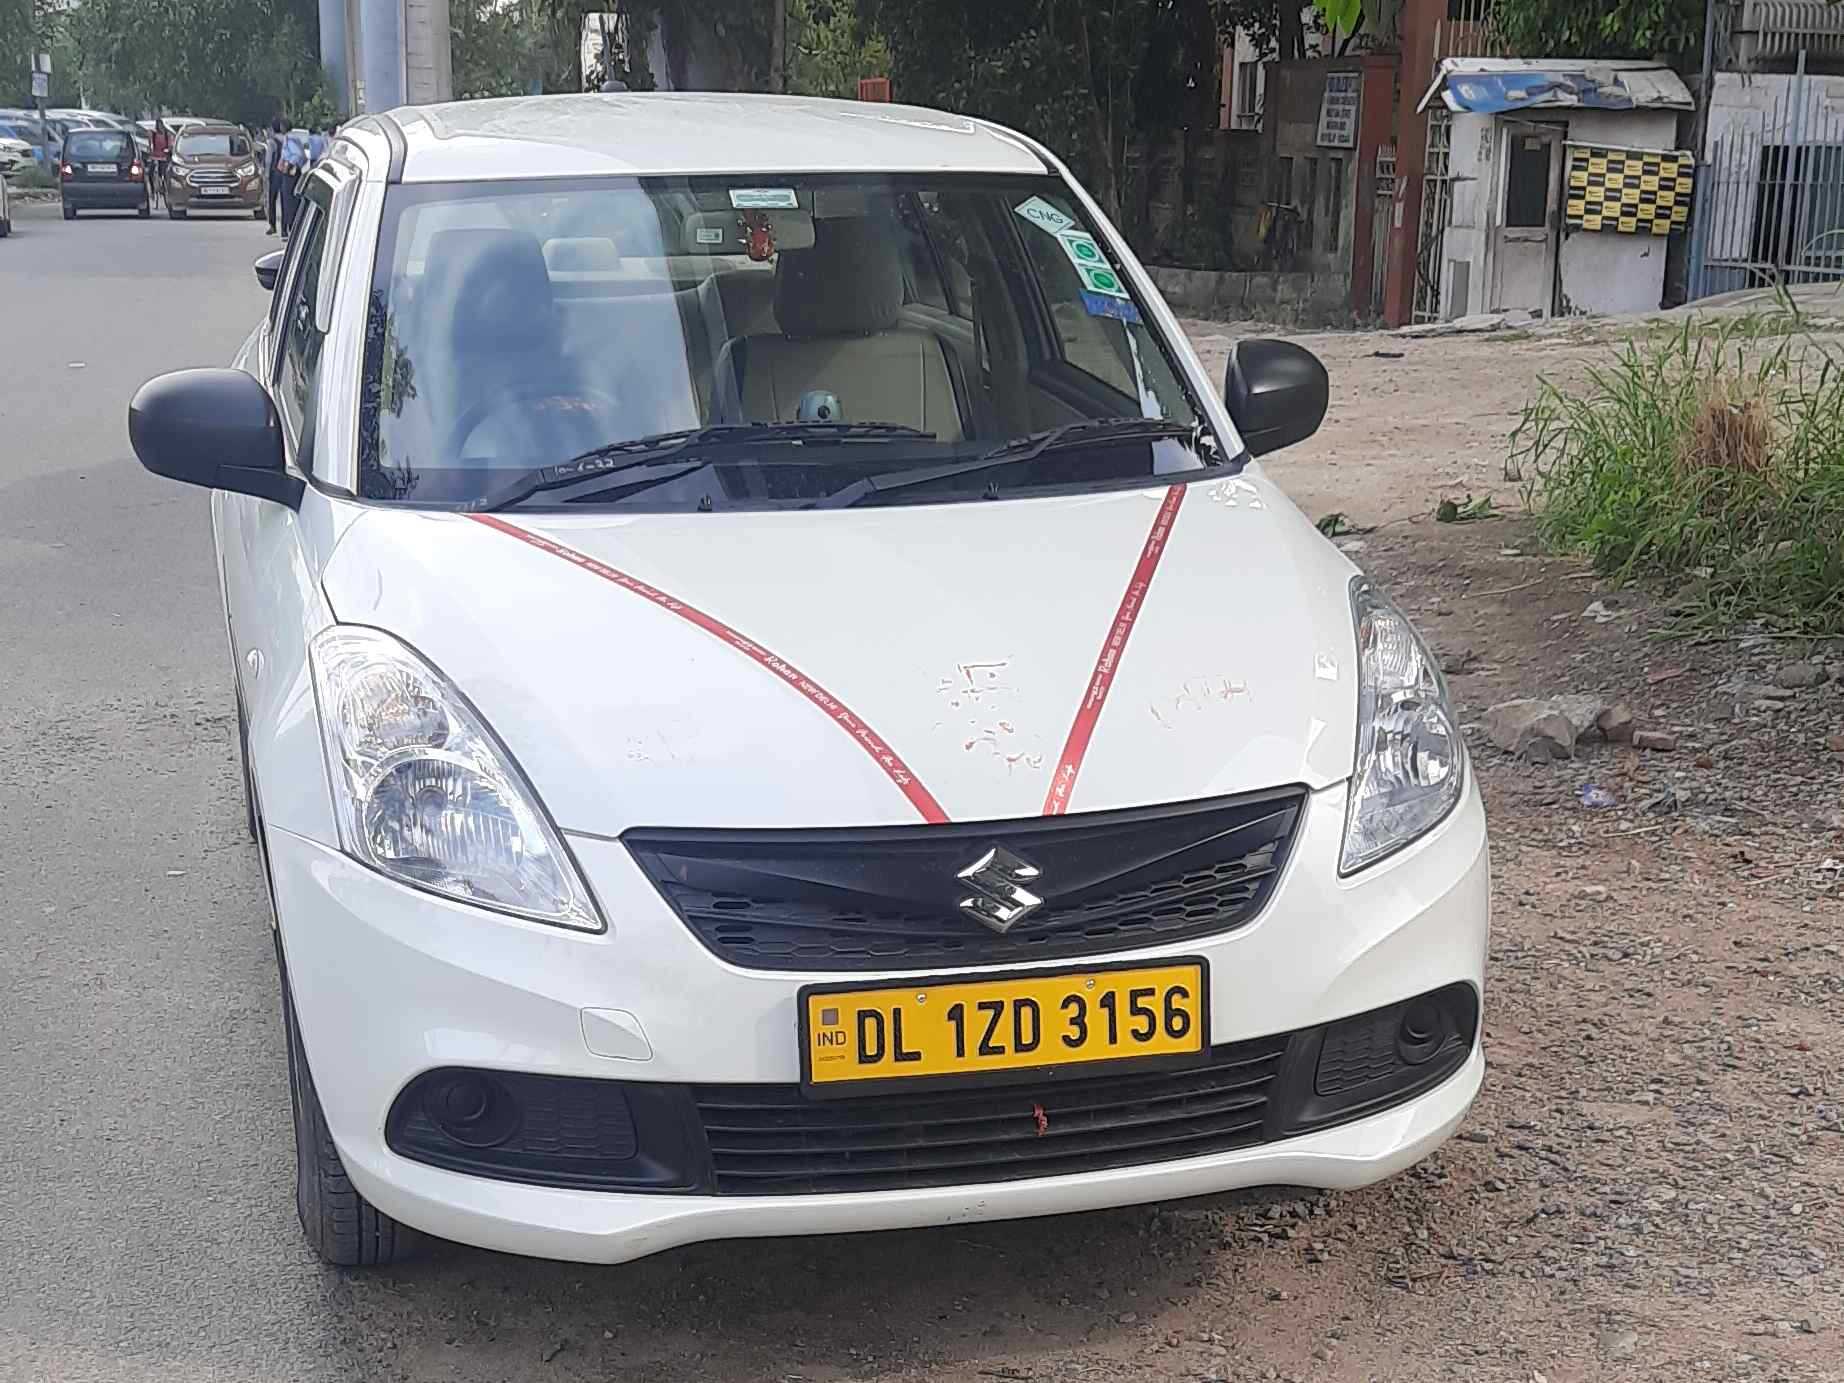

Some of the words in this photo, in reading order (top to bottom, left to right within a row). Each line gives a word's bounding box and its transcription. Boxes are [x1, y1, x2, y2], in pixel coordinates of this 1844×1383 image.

[1027, 208, 1064, 224] CNG
[857, 1007, 922, 1065] DL
[946, 998, 1041, 1058] 1ZD
[1059, 985, 1192, 1048] 3156
[817, 1031, 847, 1047] IND
